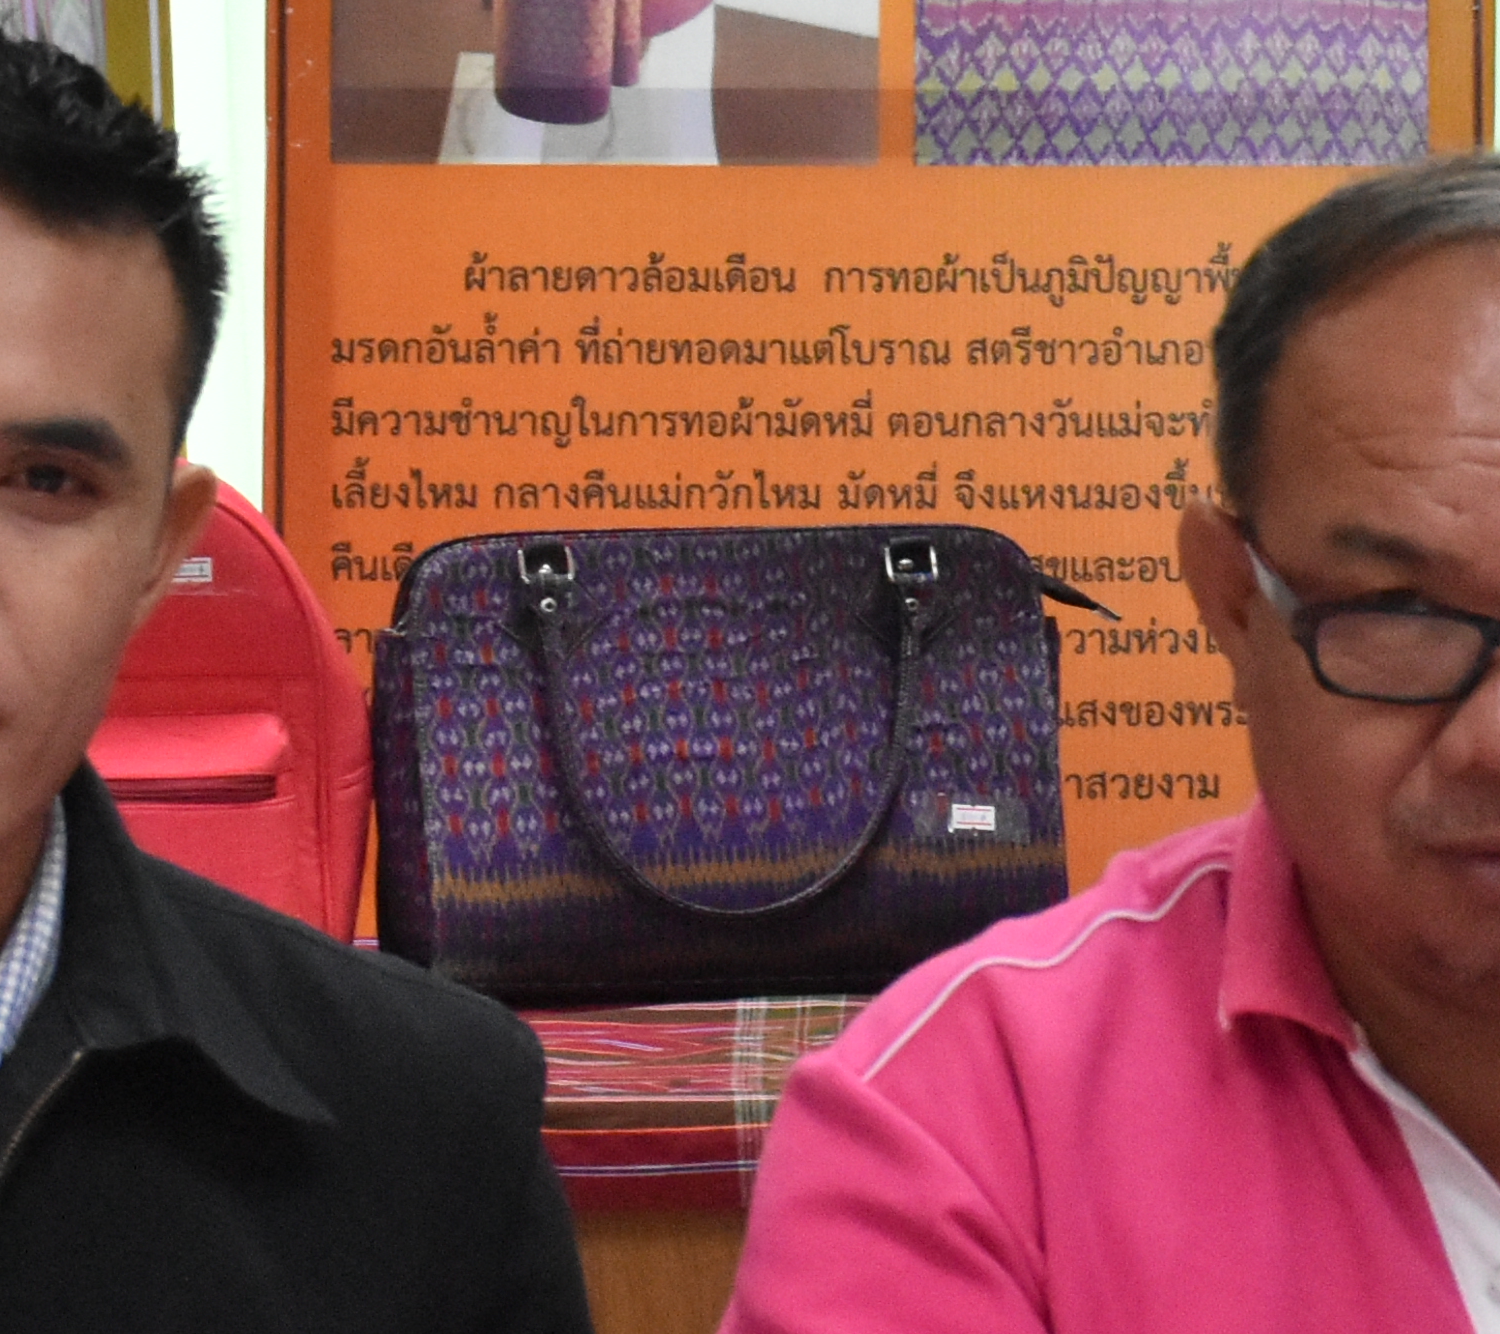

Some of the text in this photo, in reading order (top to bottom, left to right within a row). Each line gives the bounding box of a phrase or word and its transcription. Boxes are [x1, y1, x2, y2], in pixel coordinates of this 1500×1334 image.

[464, 251, 797, 294] ผ้าลายดาวล้อมเดือน
[331, 311, 561, 365] มรดกอันล้ำค่า
[331, 457, 478, 510] เลี้ยงไหม
[494, 468, 821, 510] กลางคืนแม่กวักไหม
[838, 462, 938, 510] มัดหมี่
